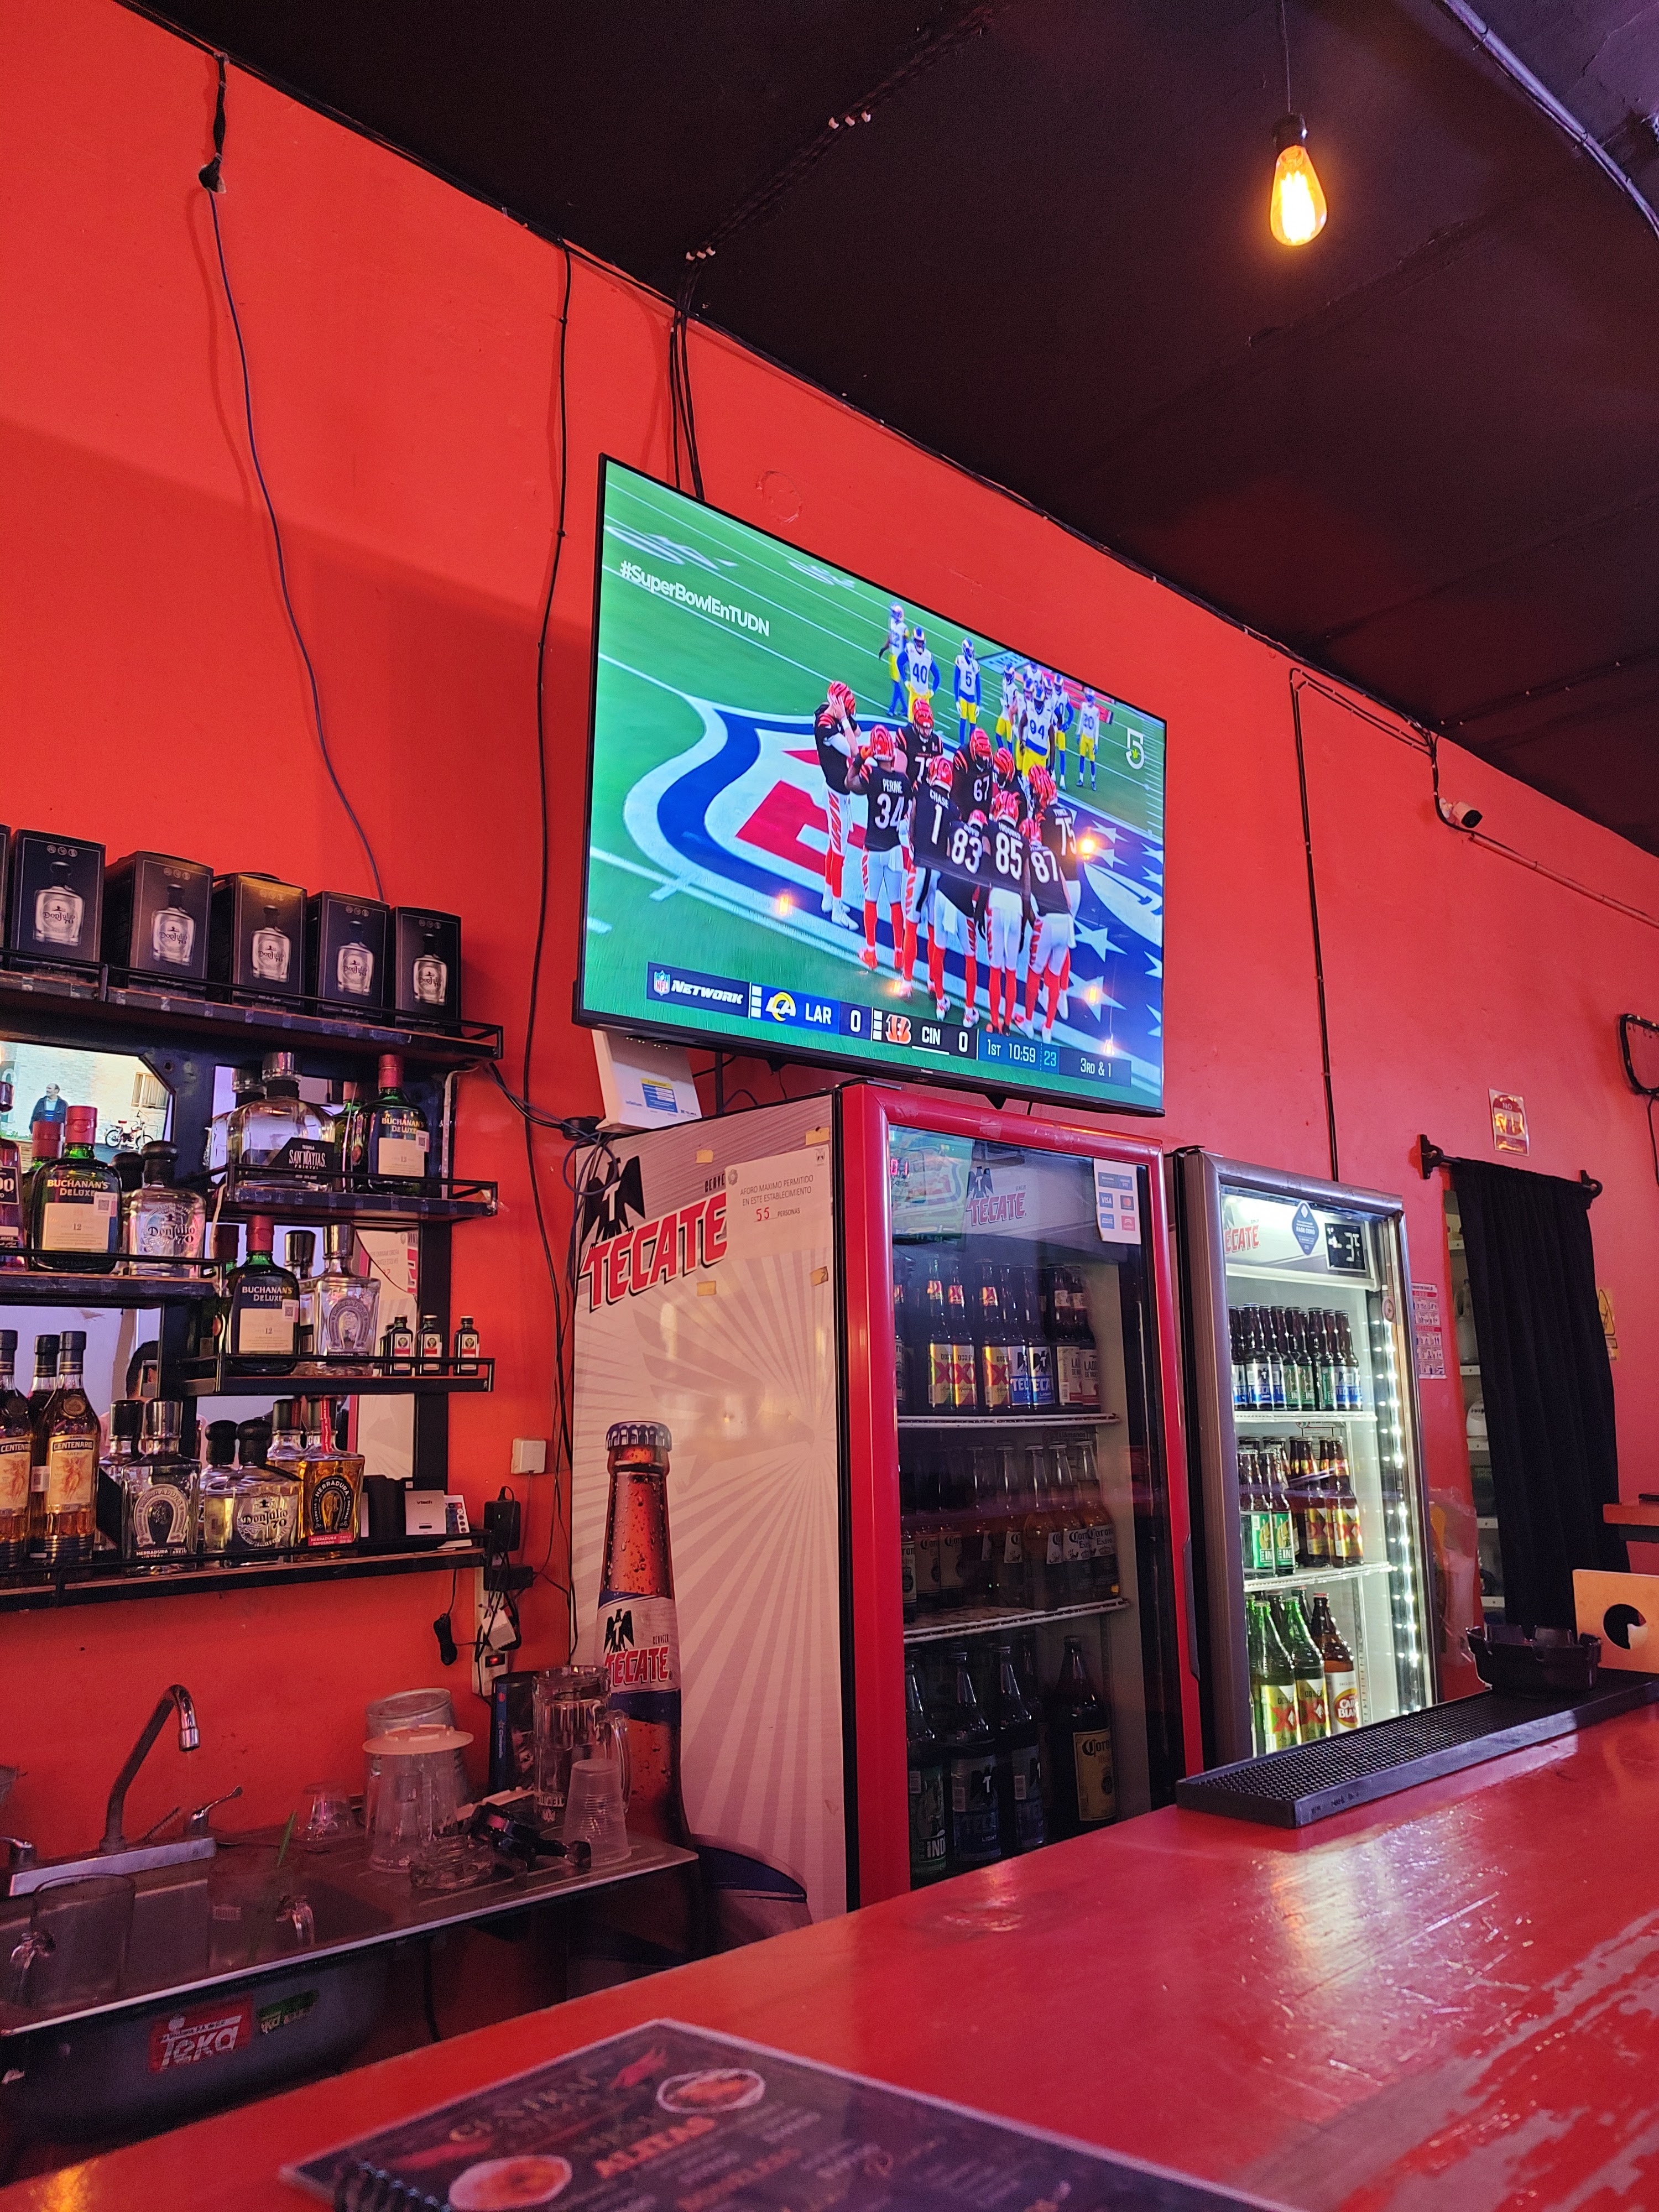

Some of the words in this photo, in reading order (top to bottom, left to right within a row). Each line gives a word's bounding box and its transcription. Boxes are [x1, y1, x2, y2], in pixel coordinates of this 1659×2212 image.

[620, 560, 770, 637] #SuperBowlEnTUDN
[913, 663, 927, 684] 40
[966, 670, 972, 687] 5
[1030, 719, 1045, 740] 94
[1083, 713, 1094, 730] 20
[1126, 728, 1145, 769] 5
[883, 779, 903, 794] PERINE
[973, 776, 990, 802] 67
[930, 789, 949, 810] CHASE
[875, 793, 905, 831] 34
[931, 804, 943, 845] 1
[1055, 817, 1077, 856] 75
[951, 828, 983, 874] 83
[995, 832, 1024, 881] 85
[1031, 850, 1058, 883] 87
[671, 979, 744, 1005] NETWORK
[805, 1003, 832, 1025] LAR
[850, 1010, 861, 1032] 0
[922, 1026, 941, 1046] CIN
[958, 1031, 968, 1053] 0
[987, 1039, 1001, 1057] 1ST
[1009, 1042, 1036, 1063] 10:59
[1044, 1050, 1057, 1067] 23
[1080, 1057, 1096, 1076] 3RD
[1098, 1061, 1105, 1077] &
[1503, 1102, 1512, 1110] NO
[382, 1118, 425, 1129] BUCHANAN'S
[289, 1149, 301, 1164] SAN
[303, 1150, 326, 1167] MATIAS
[46, 1179, 110, 1190] BUCHANAN'S
[705, 1173, 726, 1192] CERVE
[740, 1185, 758, 1196] AFORO
[759, 1180, 782, 1193] MAXIMO
[782, 1175, 813, 1188] PERMITIDO
[750, 1194, 763, 1204] ESTE
[763, 1186, 812, 1202] ESTABLECIMIENTO
[1101, 1196, 1112, 1204] VISA
[777, 1207, 800, 1218] PERSONAS
[966, 1192, 1027, 1227] TECATE
[1224, 1224, 1260, 1254] ECATE
[578, 1192, 727, 1310] TECATE
[242, 1286, 294, 1295] BUCHANAN'S
[53, 1441, 93, 1449] CENTENARIO
[315, 1480, 350, 1498] HERRADURA
[271, 1518, 287, 1528] 70
[604, 1645, 669, 1686] TECATE
[927, 1835, 946, 1858] IND
